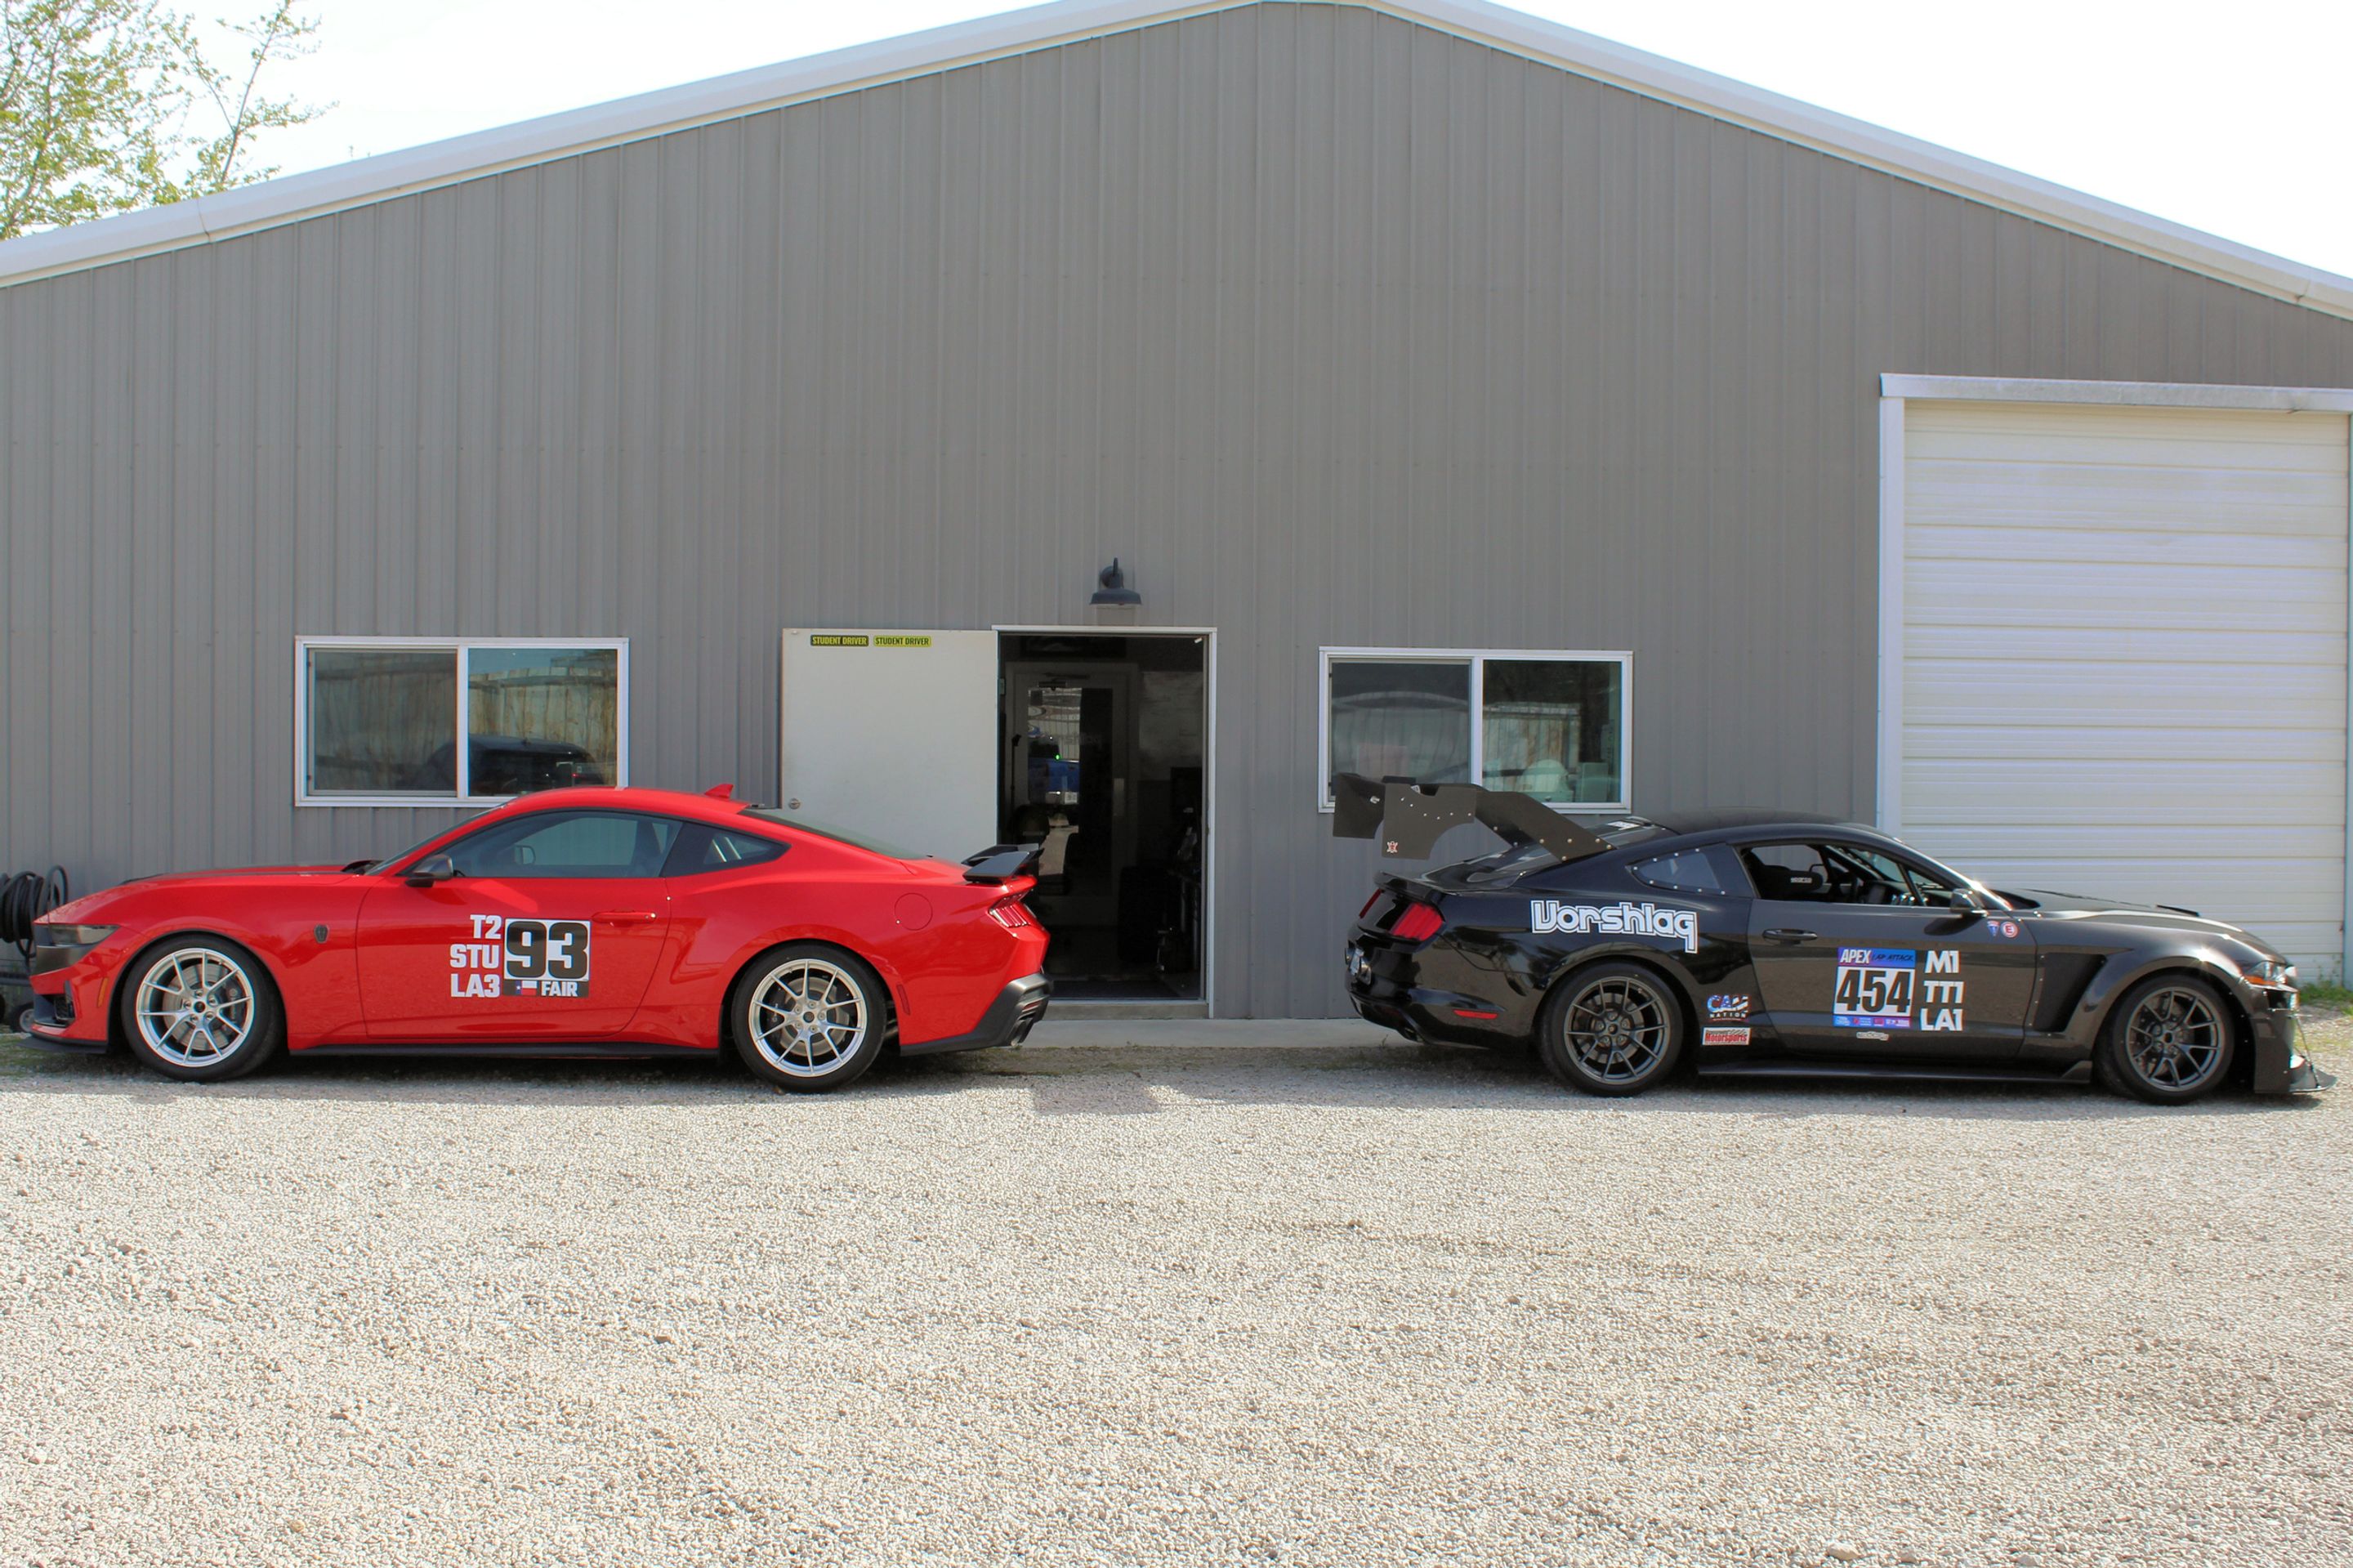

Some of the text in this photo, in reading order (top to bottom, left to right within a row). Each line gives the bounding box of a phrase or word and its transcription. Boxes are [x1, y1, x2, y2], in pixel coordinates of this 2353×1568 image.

[812, 636, 867, 646] STUDENT DRIVER
[875, 637, 930, 646] STUDENT DRIVER
[470, 914, 502, 940] T2
[449, 944, 500, 969] STU
[506, 920, 589, 980] 93
[1840, 949, 1872, 964] APEX
[1924, 949, 1960, 974] M1
[450, 973, 501, 998] LA3
[541, 981, 578, 997] FAIR
[1837, 969, 1911, 1013] 454
[1921, 1008, 1963, 1032] LA1
